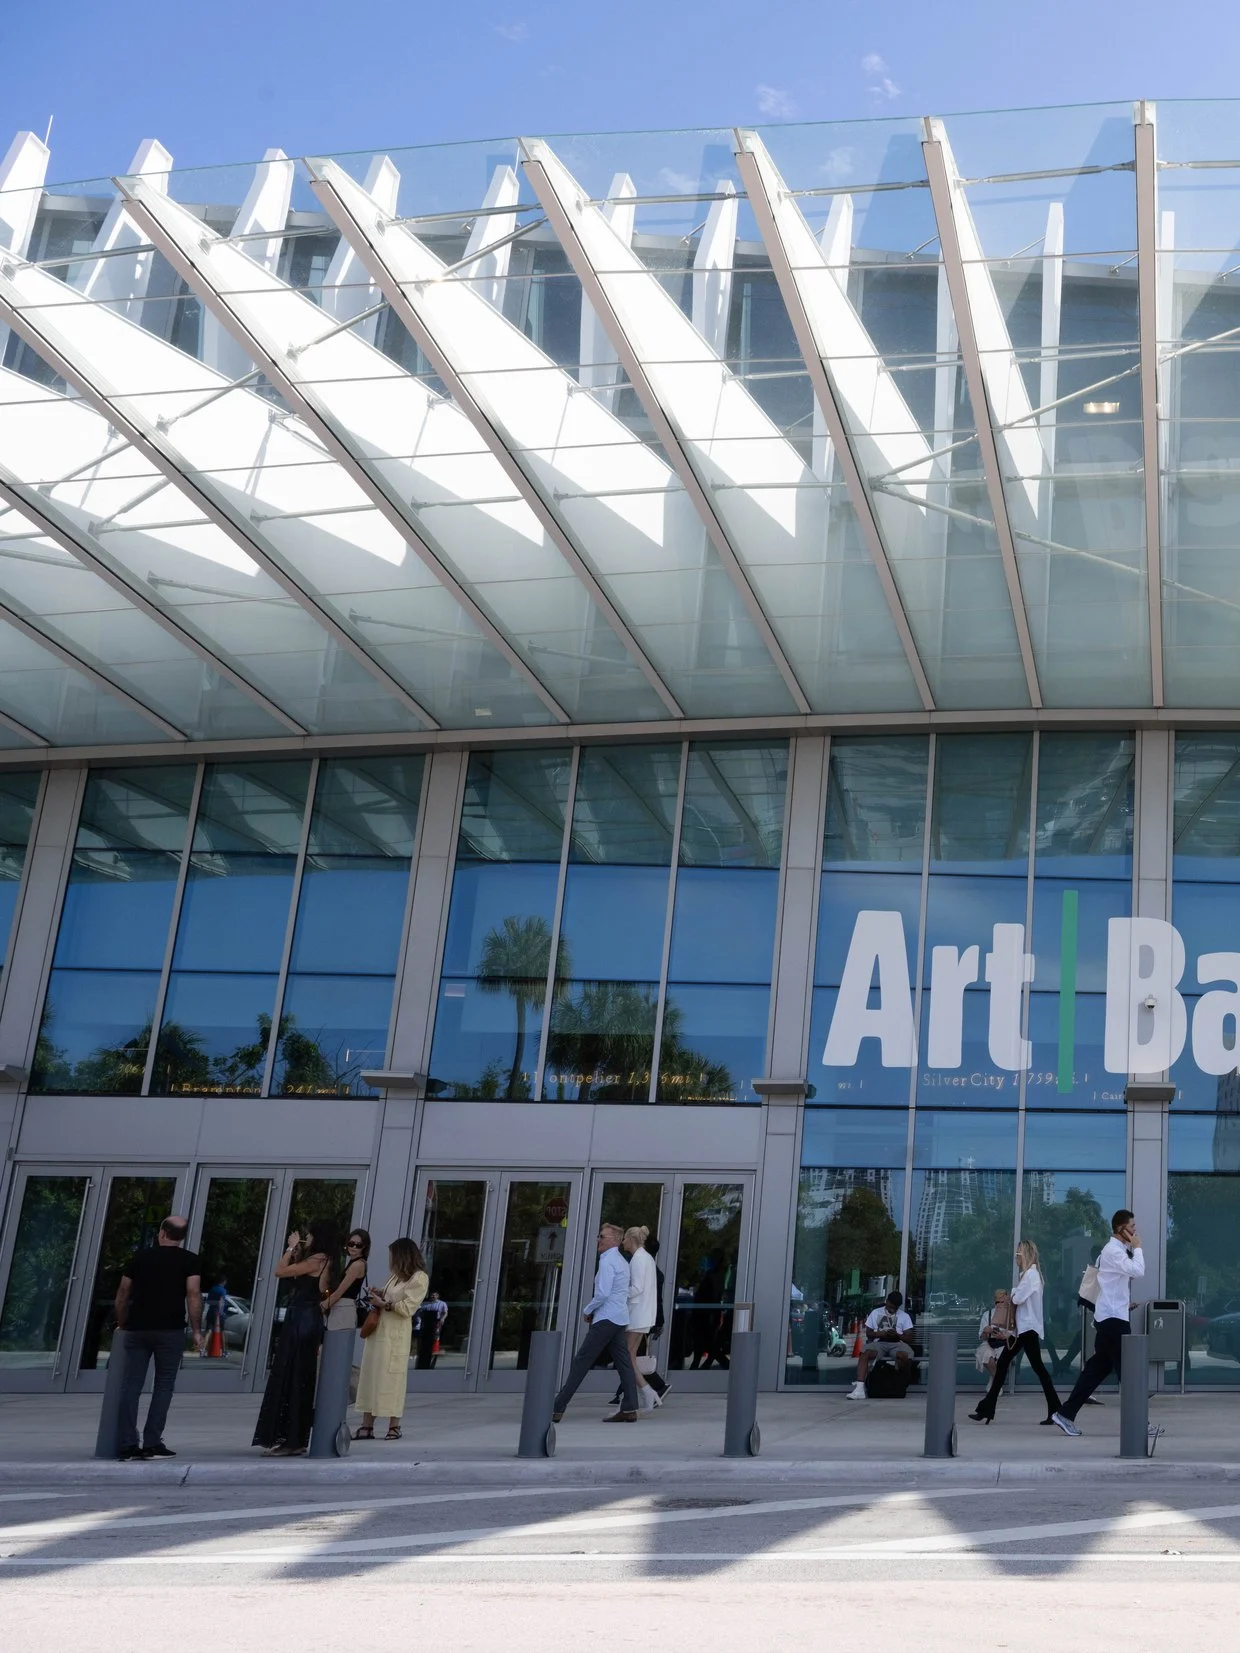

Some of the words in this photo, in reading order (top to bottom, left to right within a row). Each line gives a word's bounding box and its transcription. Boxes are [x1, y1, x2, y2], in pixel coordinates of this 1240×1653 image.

[822, 910, 1035, 1071] Art
[534, 1071, 620, 1087] ontpelier
[923, 1072, 967, 1086] Silver
[971, 1072, 1004, 1089] City
